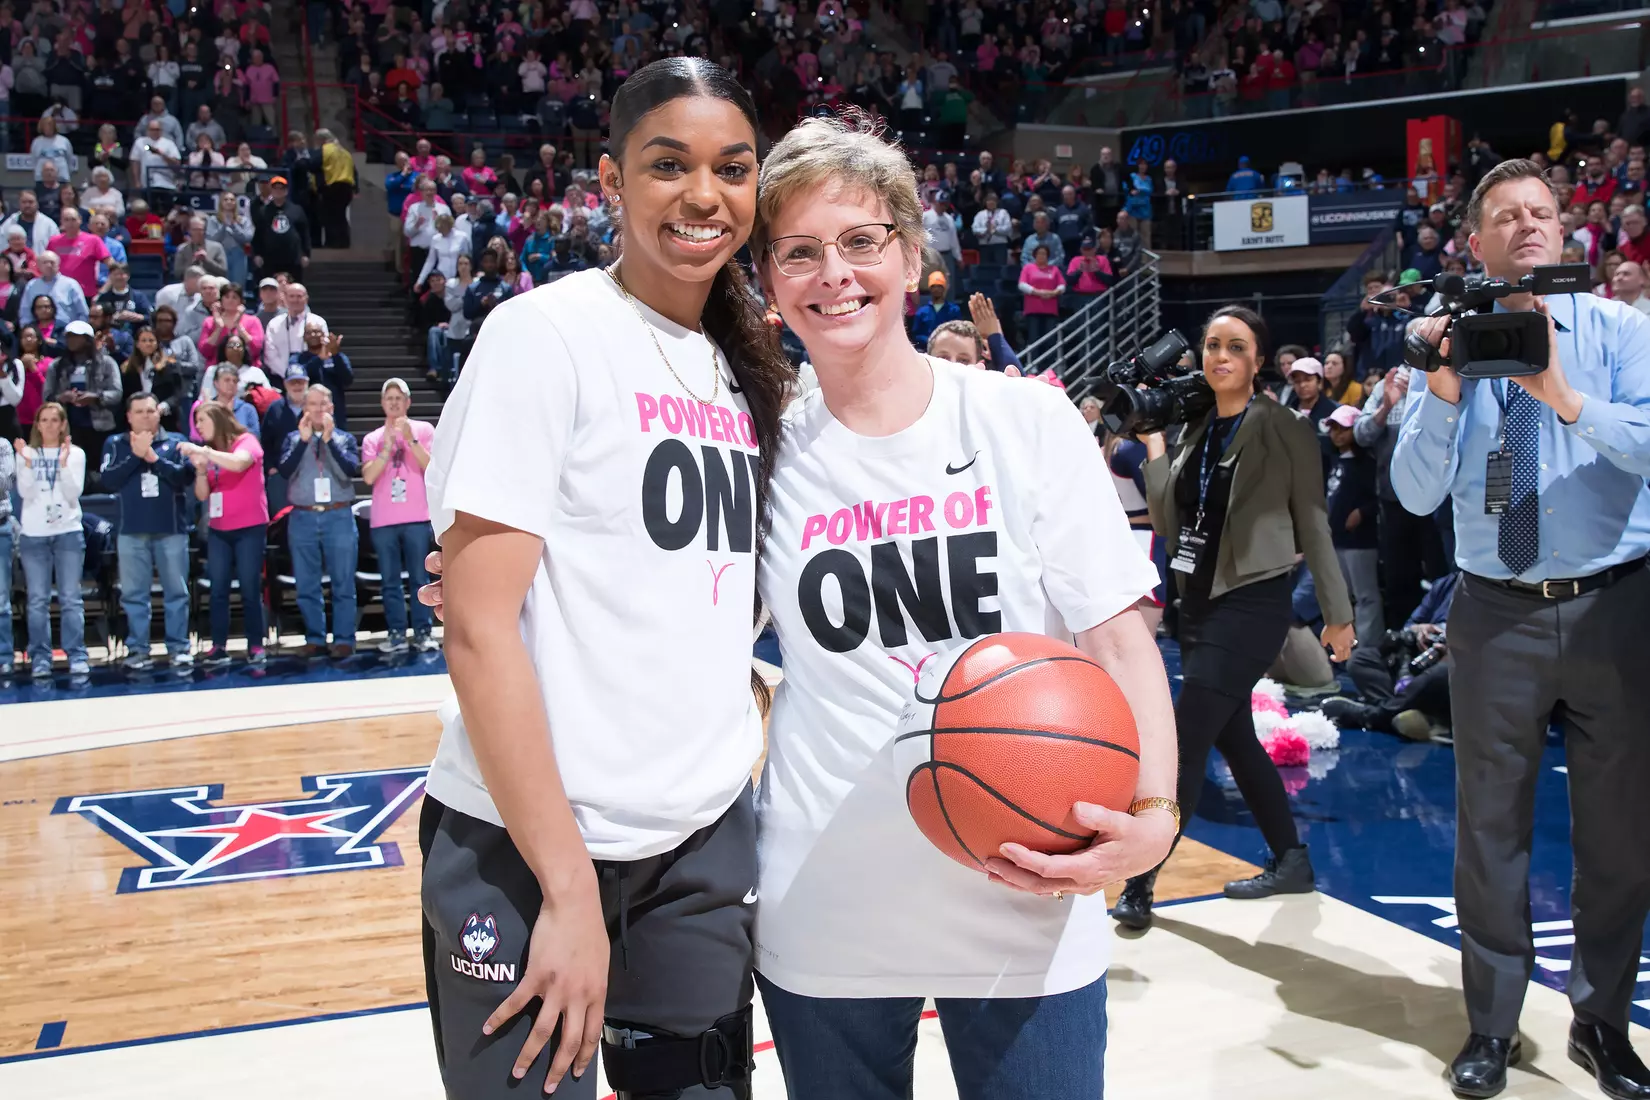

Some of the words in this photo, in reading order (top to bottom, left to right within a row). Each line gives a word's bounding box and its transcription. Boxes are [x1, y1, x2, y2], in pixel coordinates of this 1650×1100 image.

[634, 392, 741, 445] POWER
[801, 495, 936, 551] POWER
[944, 485, 993, 529] OF
[798, 531, 1002, 653] ONE
[451, 954, 515, 981] UCONN
